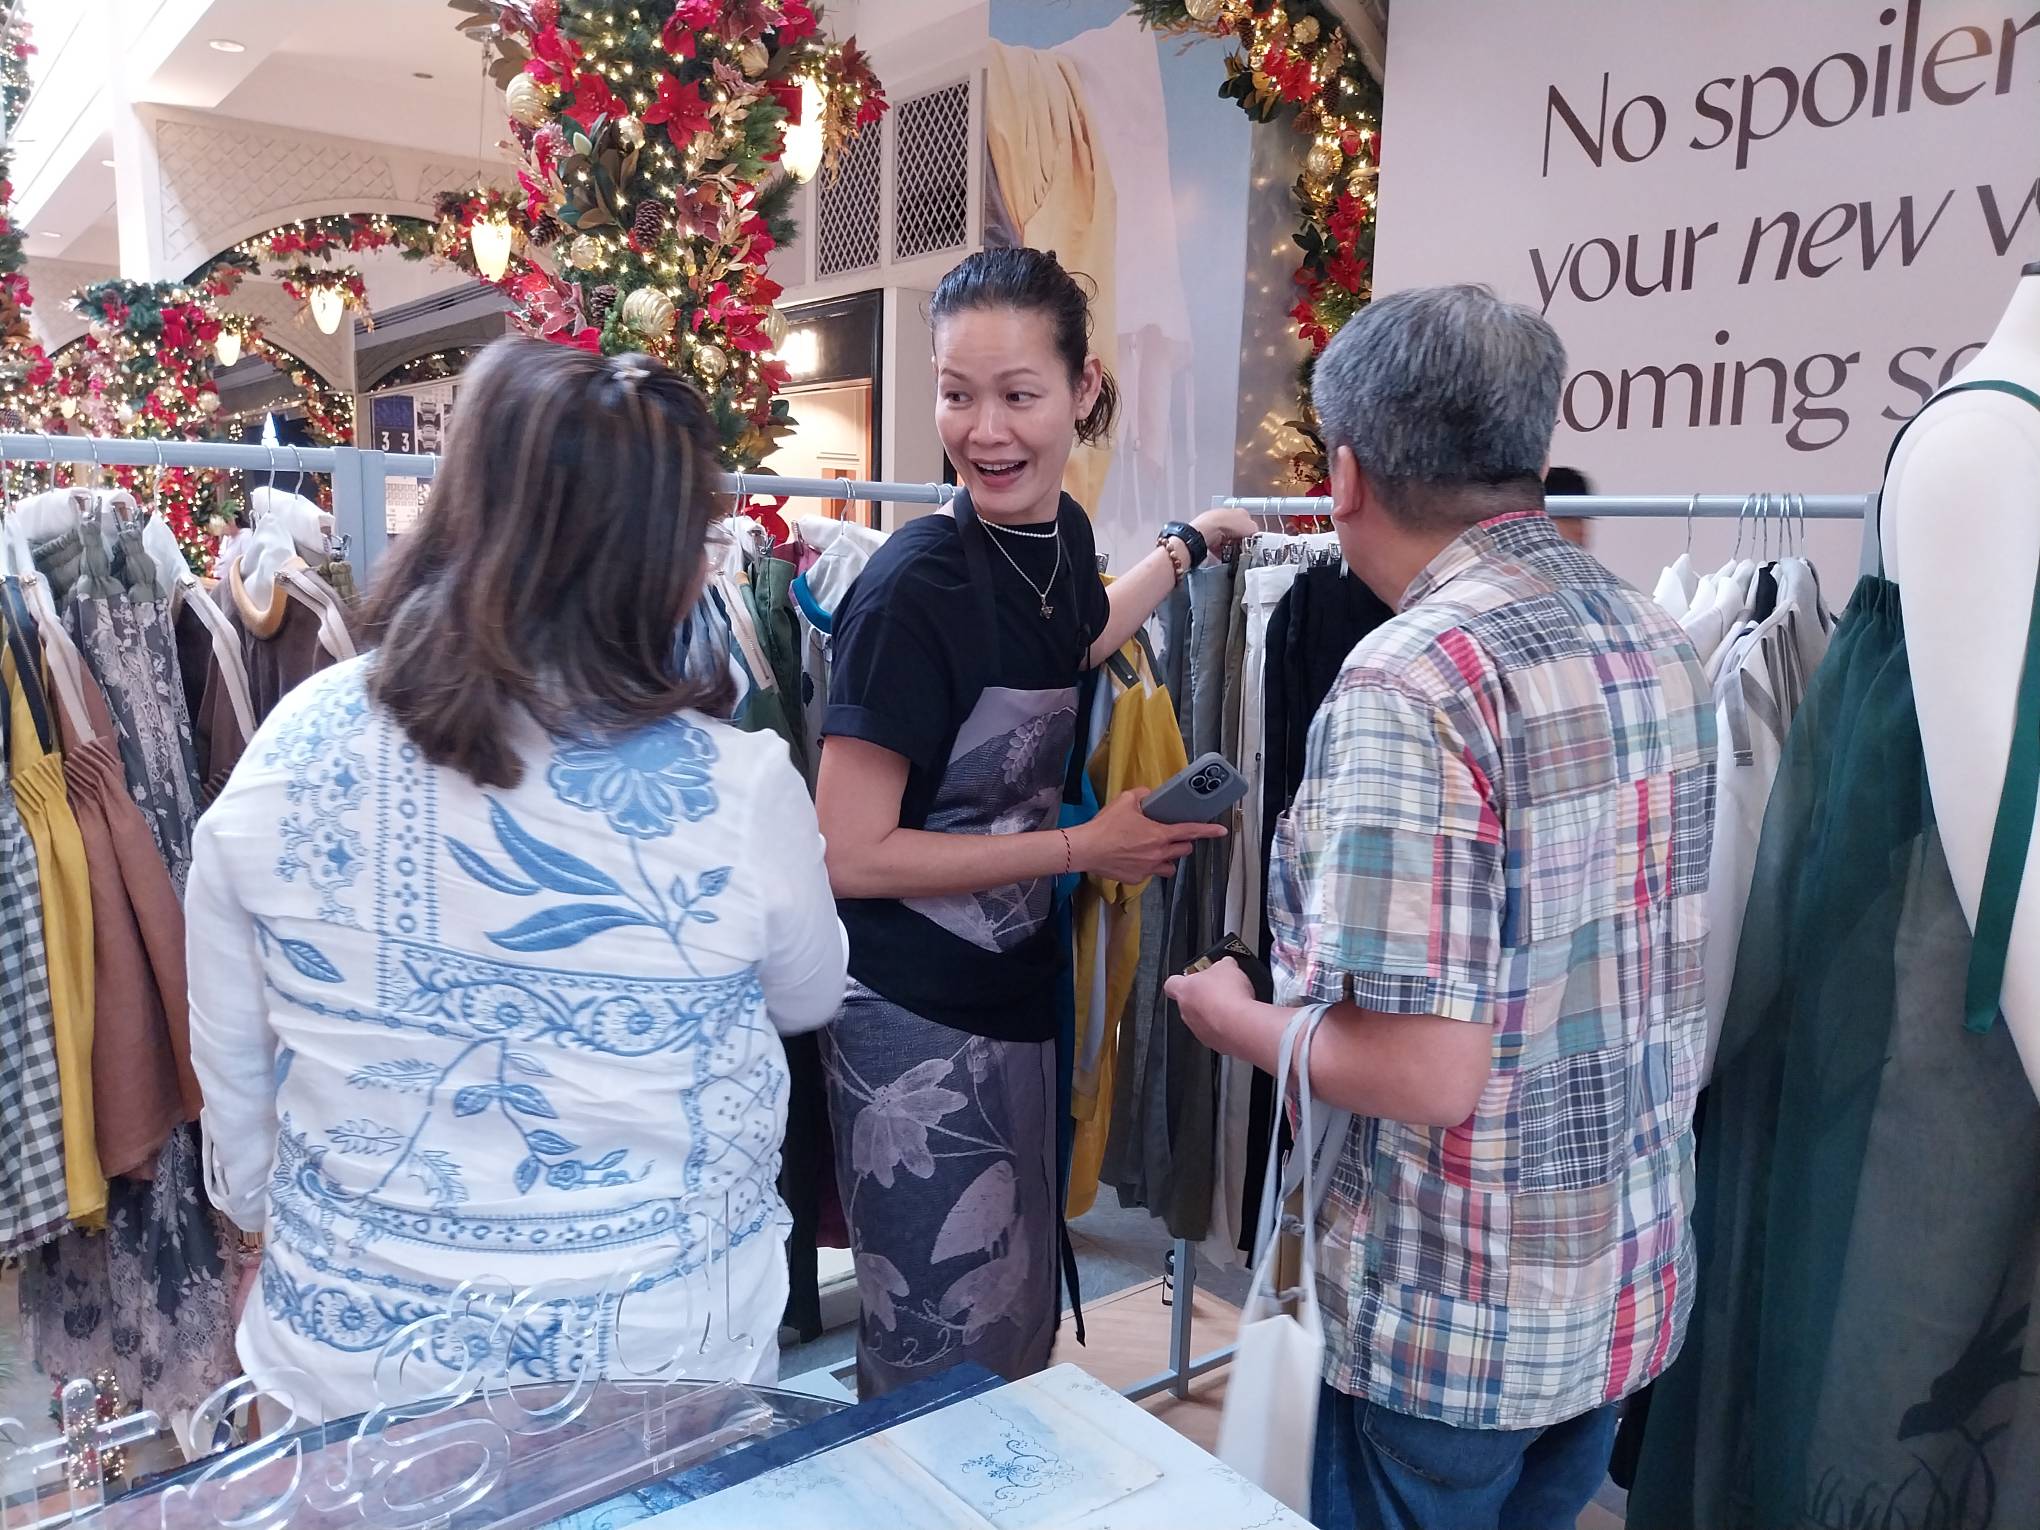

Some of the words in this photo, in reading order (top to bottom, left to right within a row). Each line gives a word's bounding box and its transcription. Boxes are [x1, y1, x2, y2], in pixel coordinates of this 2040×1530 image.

[1543, 71, 1667, 177] No
[1689, 0, 2040, 170] spoiler
[1529, 221, 1719, 316] your
[1737, 188, 1956, 285] new
[1555, 330, 1860, 452] oming
